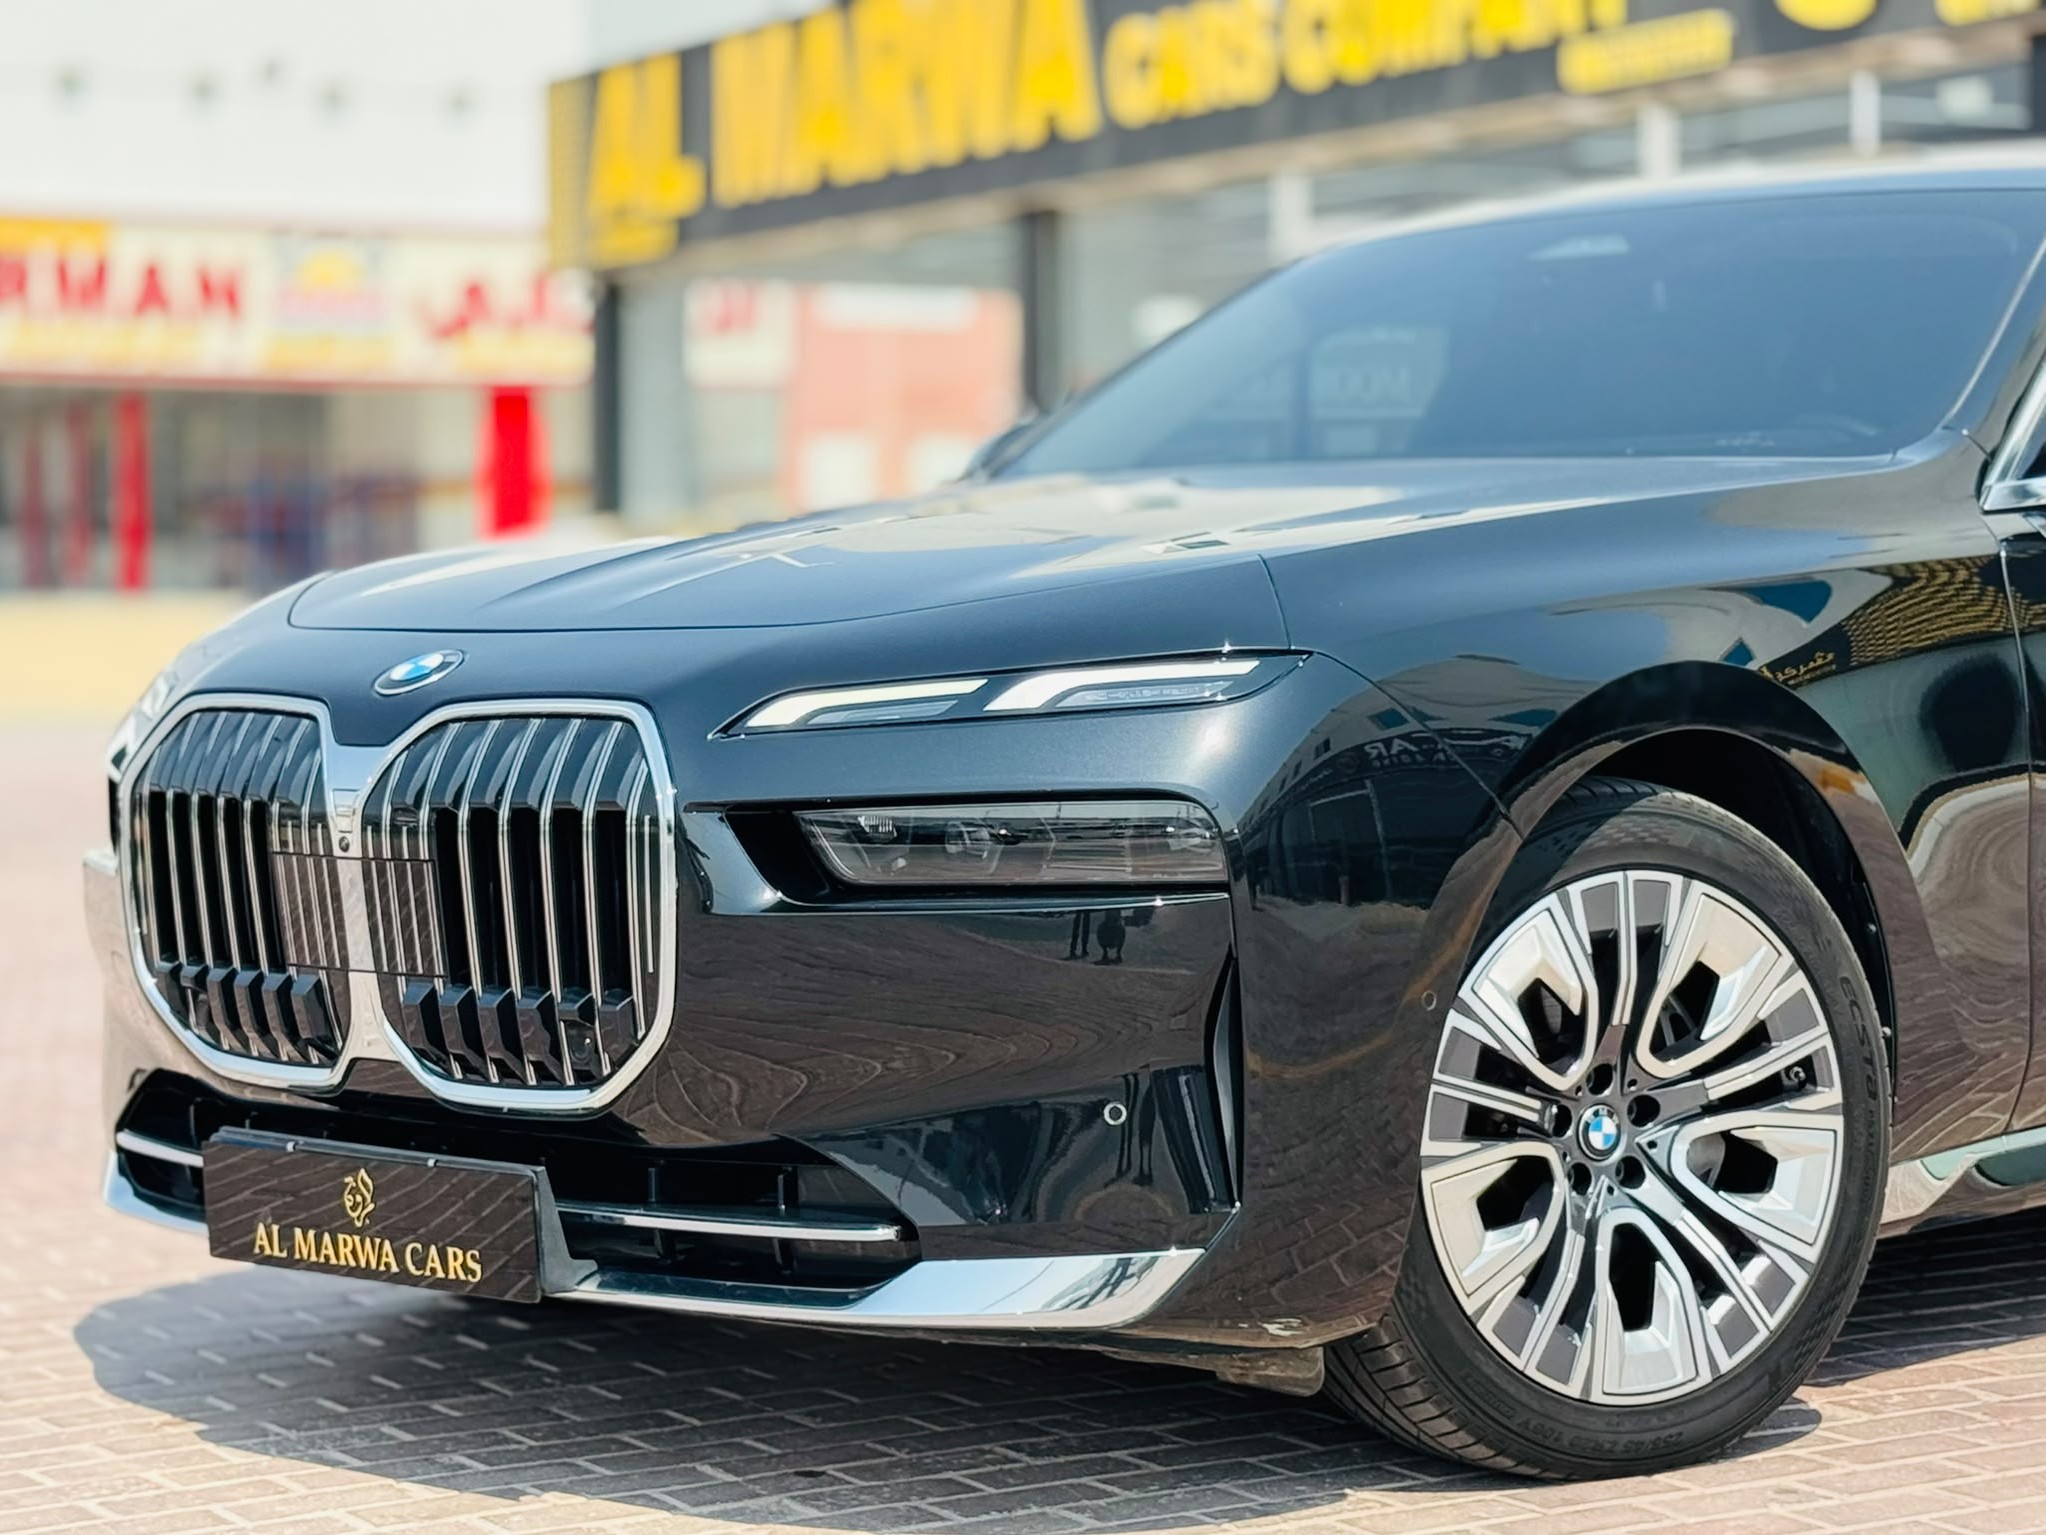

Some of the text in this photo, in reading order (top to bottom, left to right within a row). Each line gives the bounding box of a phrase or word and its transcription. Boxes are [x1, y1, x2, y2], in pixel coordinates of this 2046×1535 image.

[588, 50, 706, 222] AL
[1282, 0, 1629, 95] COMPA
[254, 1222, 484, 1284] AL MARWA CARS
